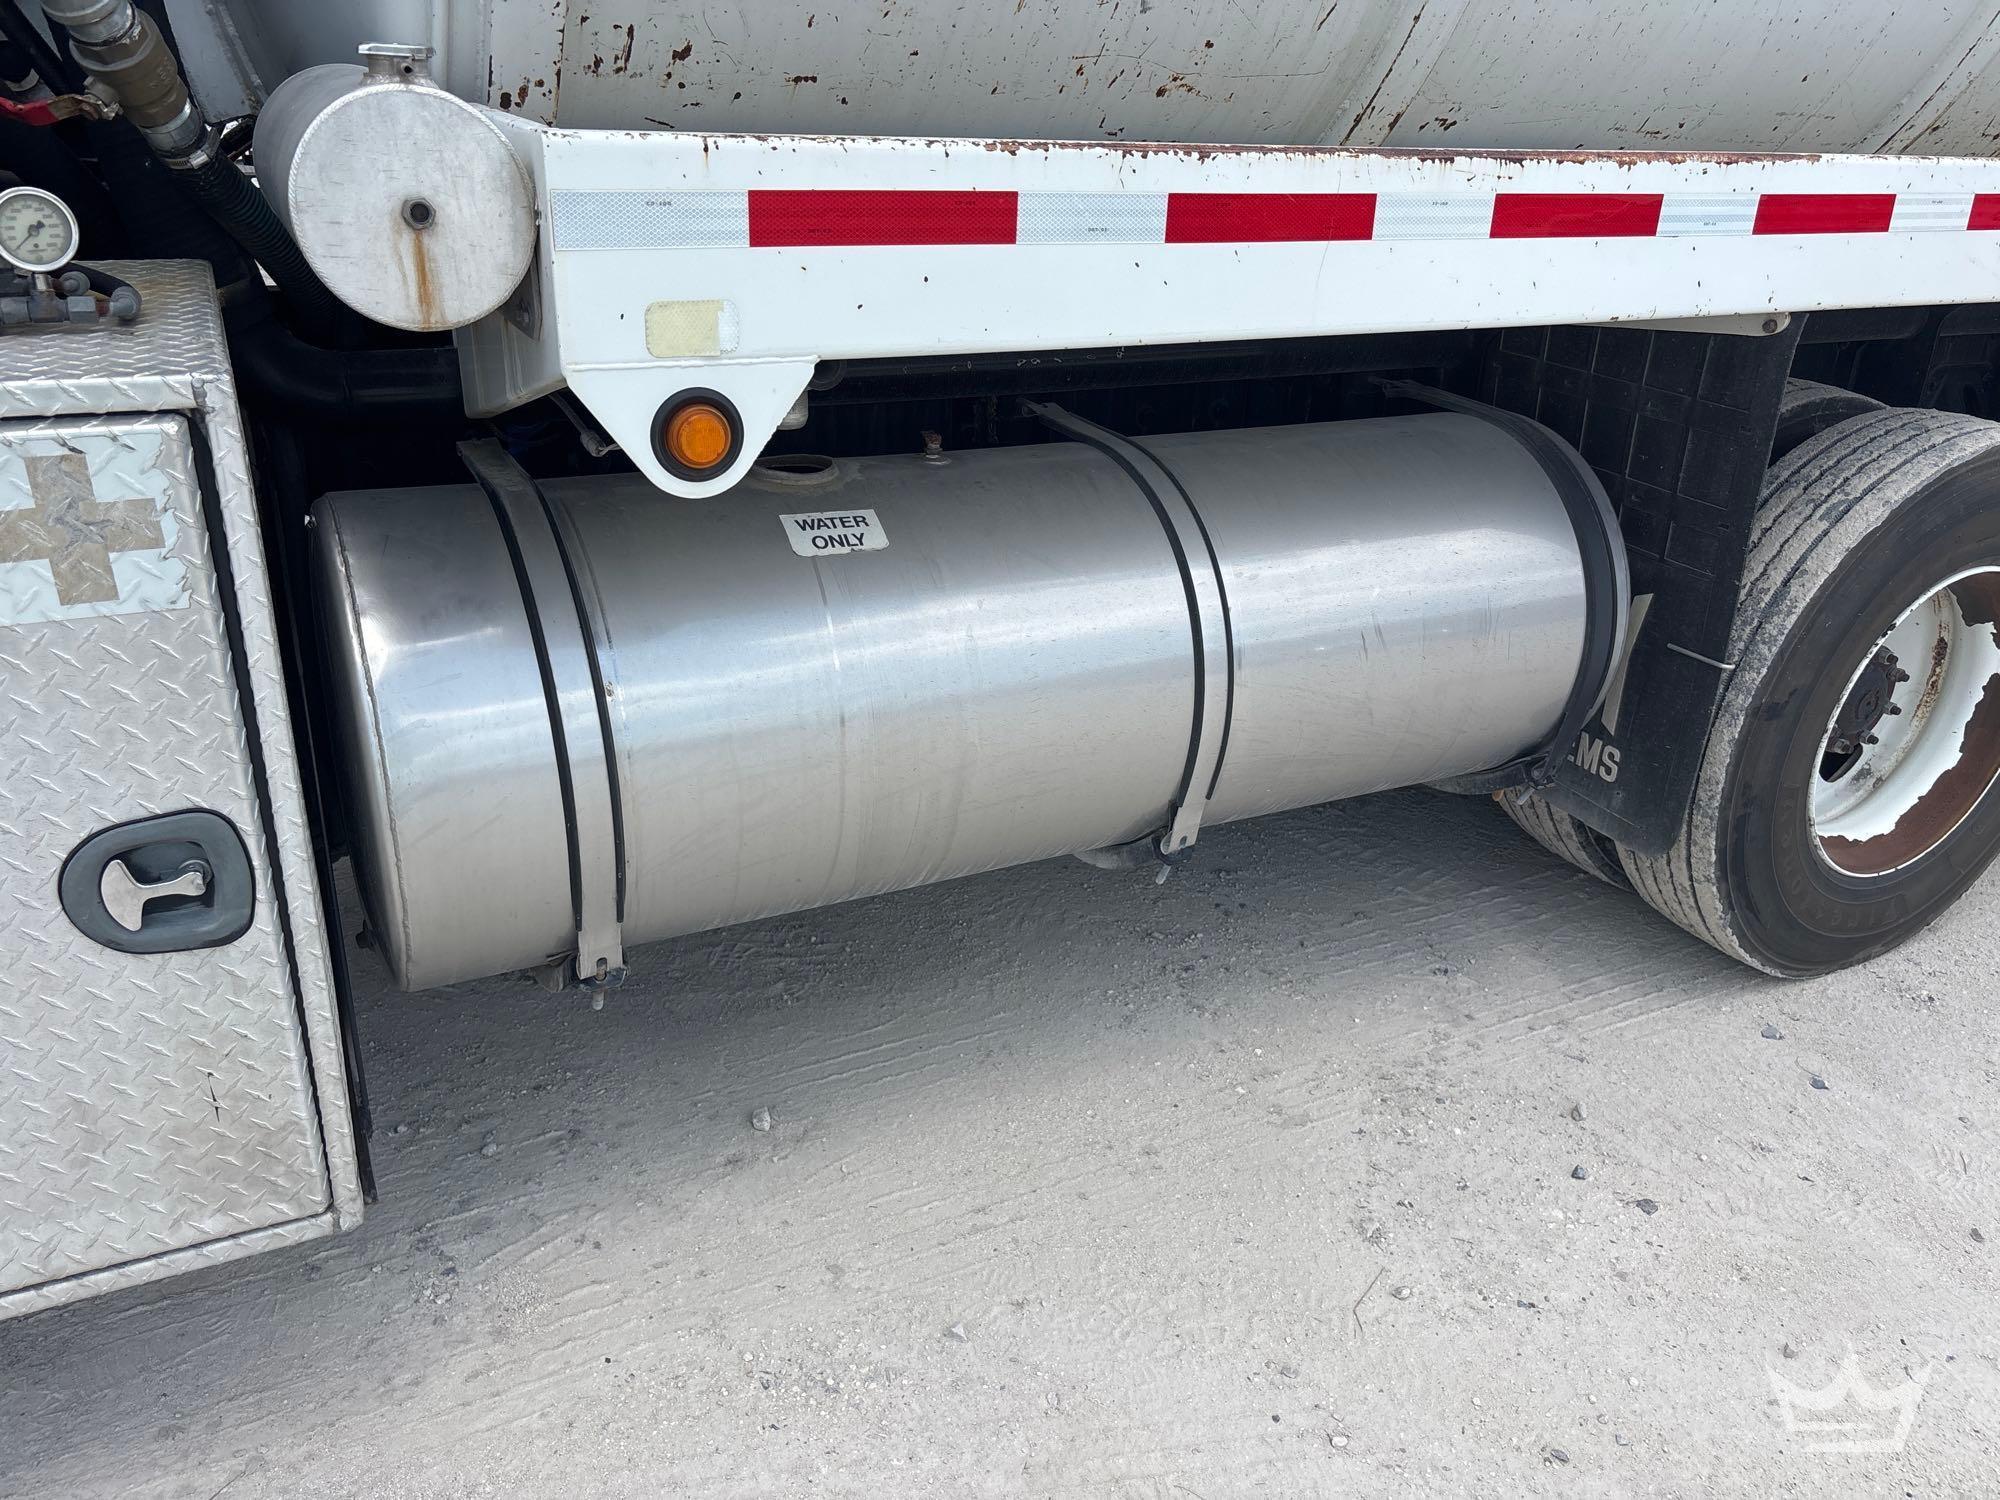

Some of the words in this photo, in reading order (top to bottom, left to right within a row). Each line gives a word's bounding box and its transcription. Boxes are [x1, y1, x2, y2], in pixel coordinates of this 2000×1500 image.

[794, 515, 870, 532] WATER
[811, 533, 865, 550] ONLY
[1567, 731, 1621, 783] MS
